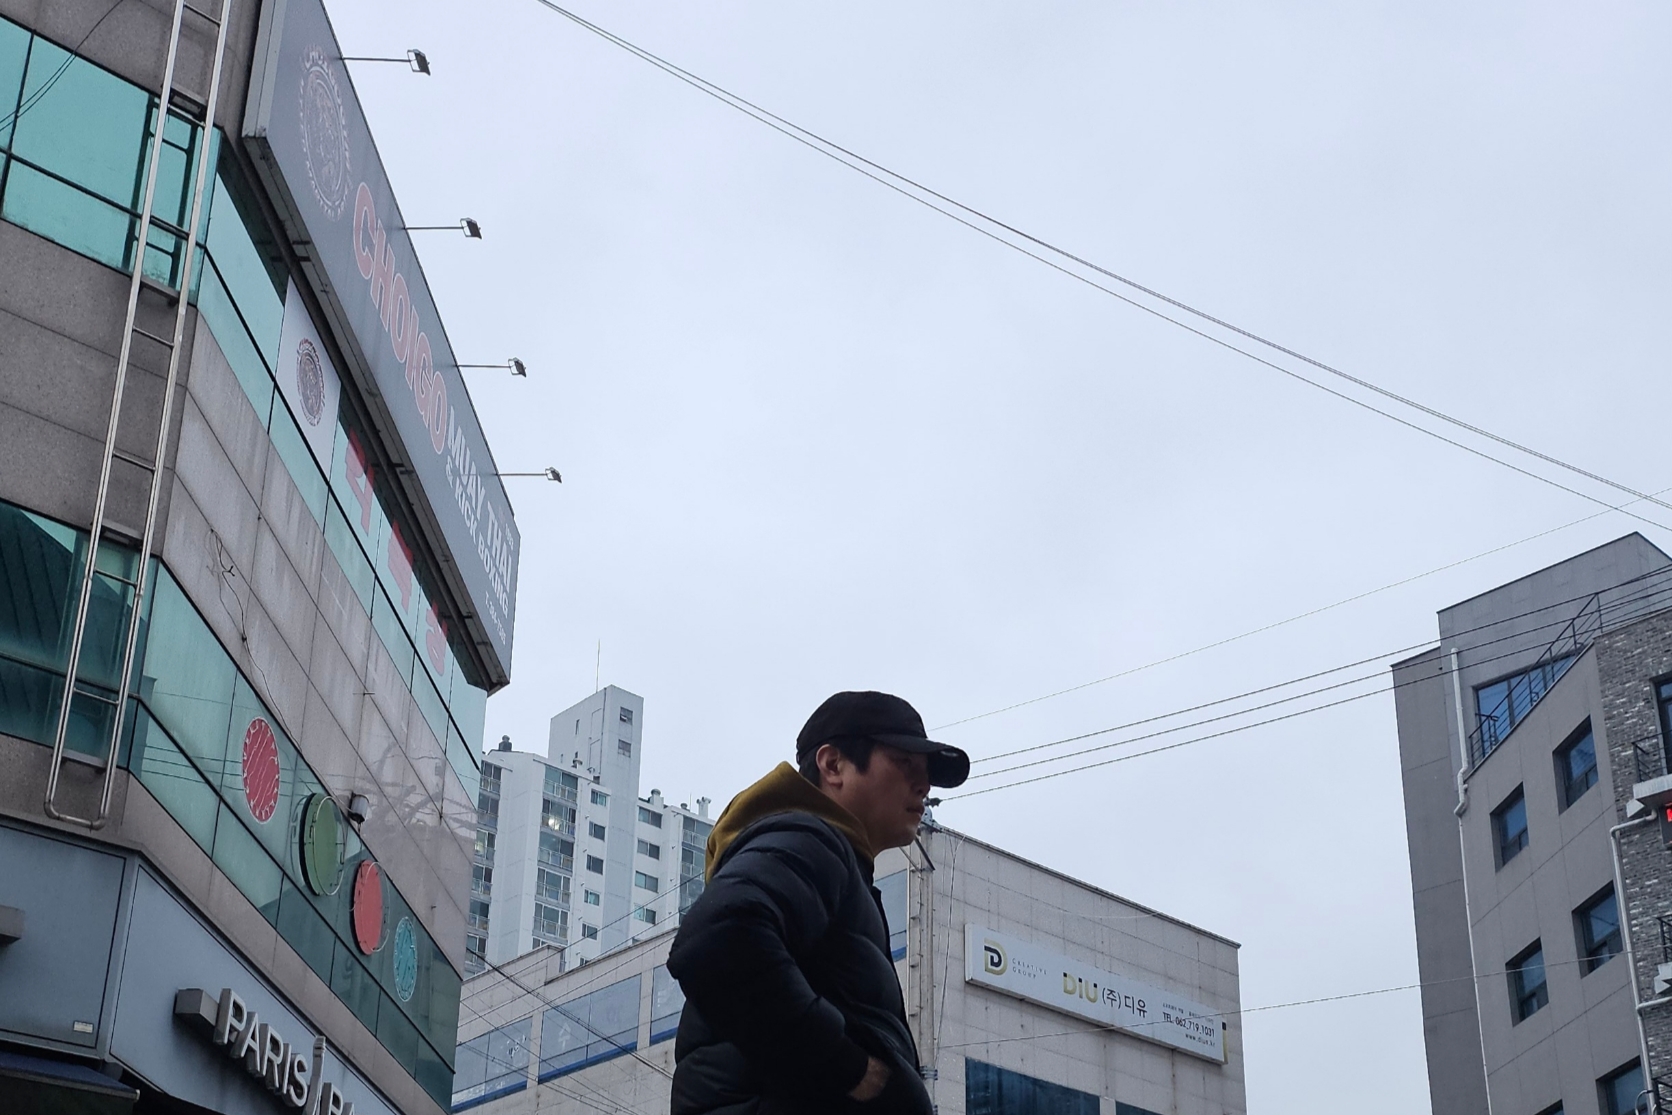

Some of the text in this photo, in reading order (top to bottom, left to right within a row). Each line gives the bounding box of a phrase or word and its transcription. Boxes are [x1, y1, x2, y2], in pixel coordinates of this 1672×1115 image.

[353, 181, 447, 455] CHOIGO
[449, 405, 512, 594] MUAY THAI
[455, 476, 477, 545] KICK
[478, 531, 509, 619] BOXING
[224, 987, 307, 1107] PARIS
